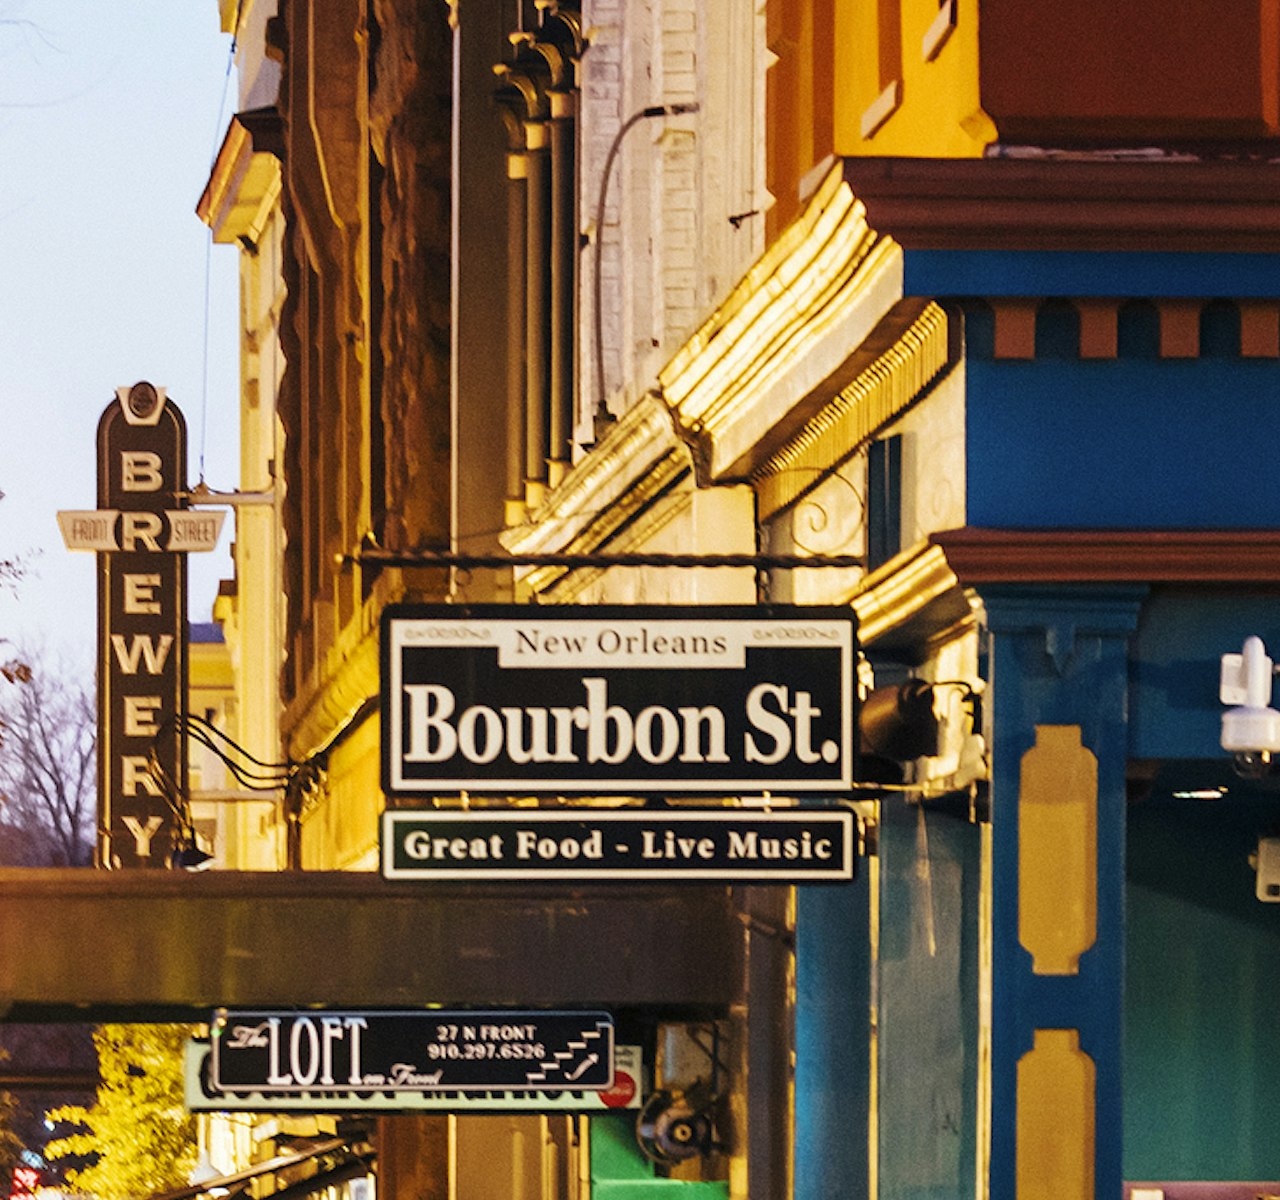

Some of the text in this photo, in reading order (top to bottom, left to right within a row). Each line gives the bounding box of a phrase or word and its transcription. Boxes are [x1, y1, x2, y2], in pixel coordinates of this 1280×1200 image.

[72, 518, 108, 541] FRONT
[175, 518, 216, 542] STREET
[110, 450, 174, 857] BREWERY
[515, 627, 728, 656] New Orleans
[402, 676, 840, 765] Bourbon St.
[403, 830, 504, 861] Great
[516, 829, 605, 861] Food
[641, 830, 715, 861] Live
[727, 829, 832, 861] Music
[436, 1024, 537, 1042] 27 N FRONT
[267, 1016, 368, 1086] LOFT
